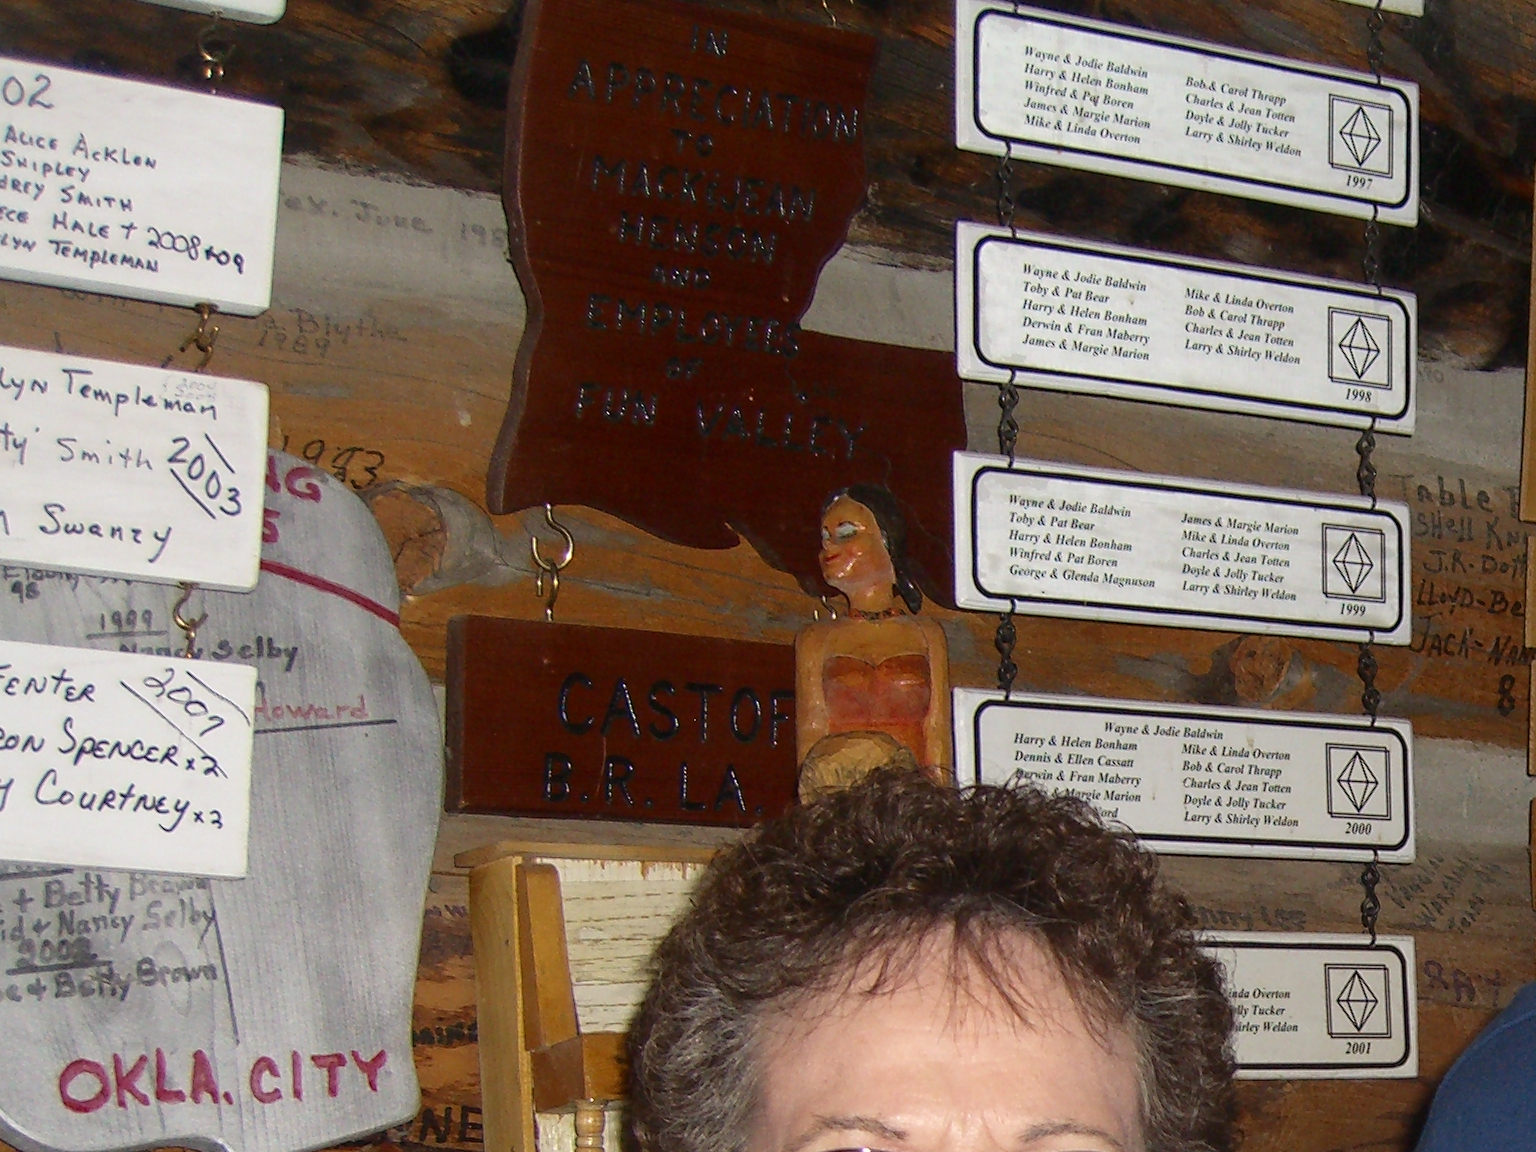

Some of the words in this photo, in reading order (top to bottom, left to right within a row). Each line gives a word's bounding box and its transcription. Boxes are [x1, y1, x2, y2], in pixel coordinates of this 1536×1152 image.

[690, 24, 728, 56] IN
[569, 59, 861, 145] APPRECIATION
[1023, 97, 1057, 113] James
[1072, 105, 1110, 125] Margie
[1112, 112, 1151, 129] Marion
[1184, 92, 1224, 110] Charles
[1238, 101, 1262, 117] Jean
[1264, 106, 1296, 123] Totten
[672, 128, 714, 158] TO
[1345, 175, 1374, 190] 1997
[618, 211, 778, 266] HENSON
[651, 262, 711, 291] AND
[1184, 287, 1210, 302] Mike
[1224, 293, 1254, 308] Linda
[1255, 297, 1295, 314] Overton
[586, 294, 801, 360] EMPLOYEES
[1022, 315, 1062, 332] Derwin
[1077, 323, 1103, 337] Fran
[1106, 327, 1150, 347] Maberry
[665, 357, 703, 380] OF
[1344, 388, 1373, 403] 1998
[575, 382, 658, 427] FUN
[698, 400, 868, 459] VALLEY
[57, 438, 152, 470] Smith
[167, 436, 243, 516] 2003
[1008, 562, 1047, 579] George
[1061, 567, 1100, 582] Glenda
[1102, 572, 1156, 590] Magnuson
[1182, 562, 1211, 578] Doyle
[1224, 566, 1249, 582] Jolly
[1250, 569, 1284, 583] Tucker
[1339, 603, 1367, 617] 1999
[143, 668, 225, 737] 2007
[1103, 722, 1139, 738] Wayne
[1152, 726, 1180, 739] Jodie
[1182, 728, 1224, 742] Baldwin
[1014, 749, 1052, 762] Dennis
[1067, 752, 1095, 765] Ellen
[1096, 754, 1134, 767] Cassatt
[679, 762, 766, 815] LA.
[1184, 810, 1212, 825] Larry
[1225, 813, 1261, 828] Shirley
[1262, 815, 1299, 828] Weldon
[1345, 823, 1373, 837] 2000
[1252, 988, 1290, 1000] Overton
[1252, 1005, 1286, 1016] Tucker
[1262, 1022, 1299, 1033] Weldon
[1345, 1042, 1371, 1055] 2001
[58, 1048, 234, 1114] OKLA.
[250, 1049, 387, 1104] CITY
